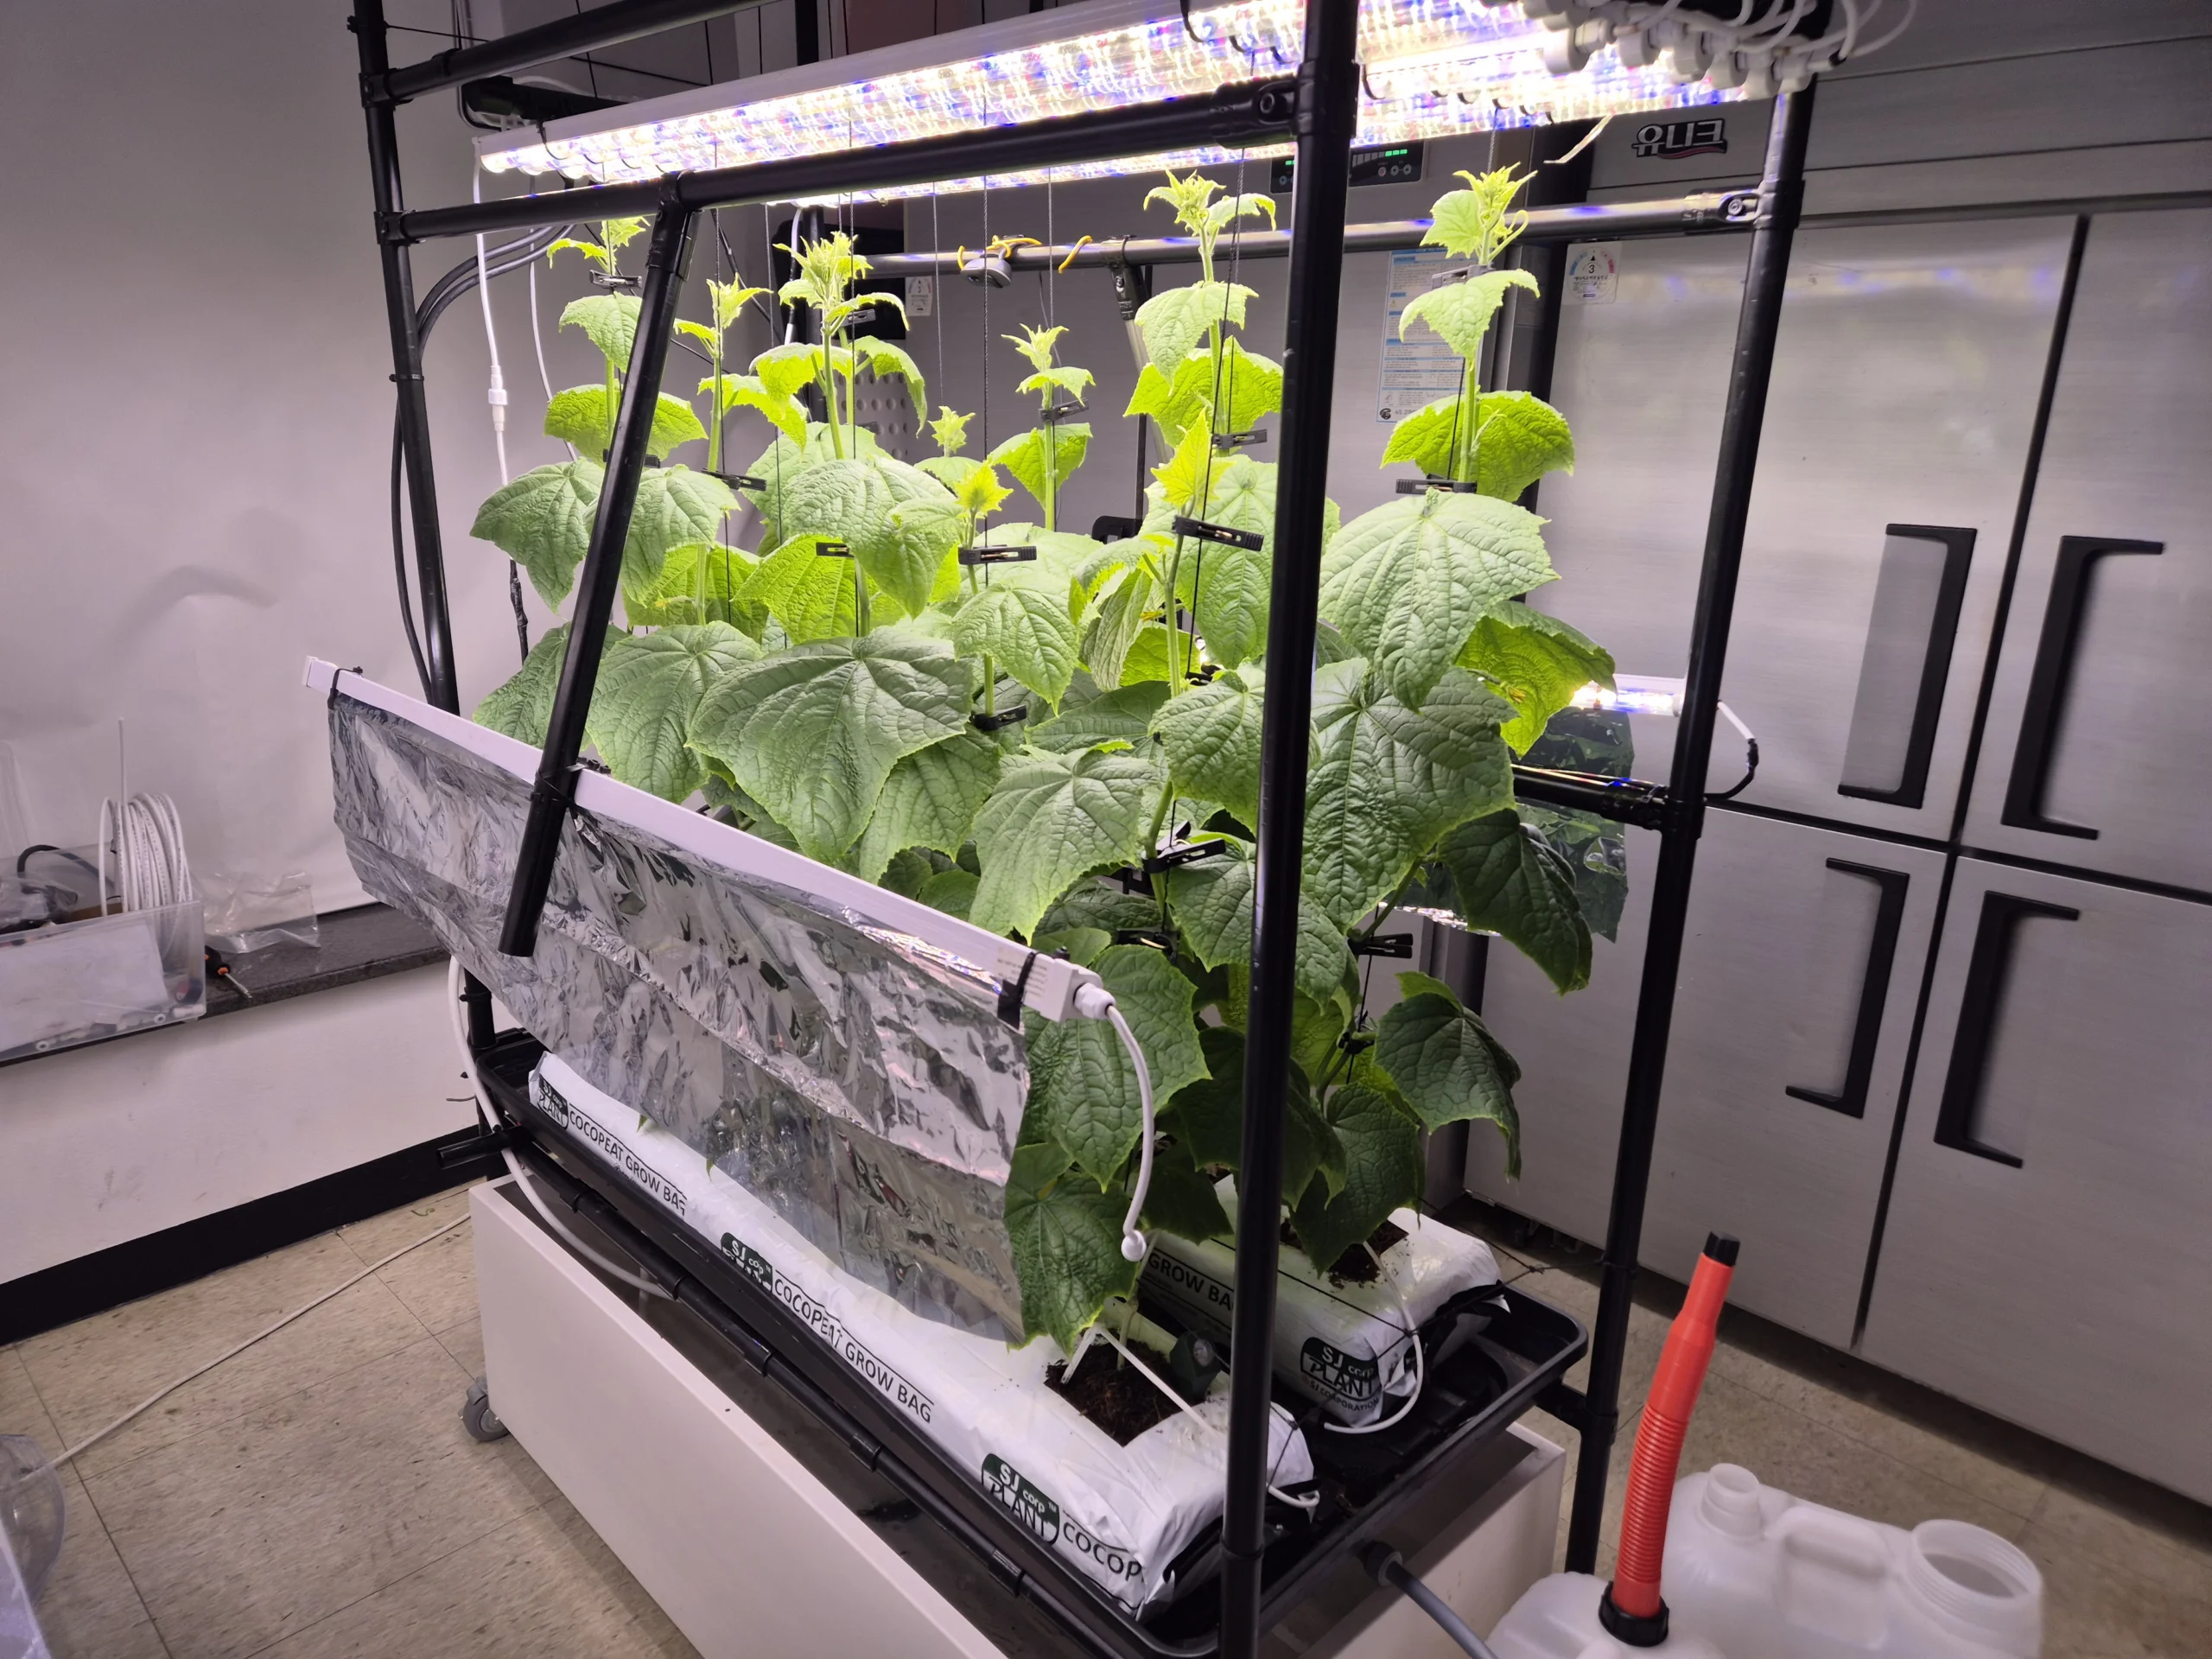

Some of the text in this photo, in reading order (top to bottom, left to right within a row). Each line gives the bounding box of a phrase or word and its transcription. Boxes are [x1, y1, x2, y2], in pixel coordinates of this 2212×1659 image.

[1633, 120, 1724, 156] 유니크
[1589, 264, 1594, 274] 3
[569, 1110, 624, 1162] COCOPEAT
[626, 1155, 660, 1192] GROW
[732, 1240, 746, 1265] SJ
[1148, 1253, 1204, 1293] GROW
[1209, 1285, 1233, 1311] BA
[774, 1279, 931, 1423] COCOPEAT GROW BAG
[1321, 1346, 1344, 1368] SJ
[1309, 1357, 1373, 1397] PLANT
[988, 1475, 1049, 1536] PLANT
[1000, 1463, 1020, 1492] SJ
[1022, 1489, 1046, 1513] corp
[1063, 1522, 1144, 1582] COCOP
